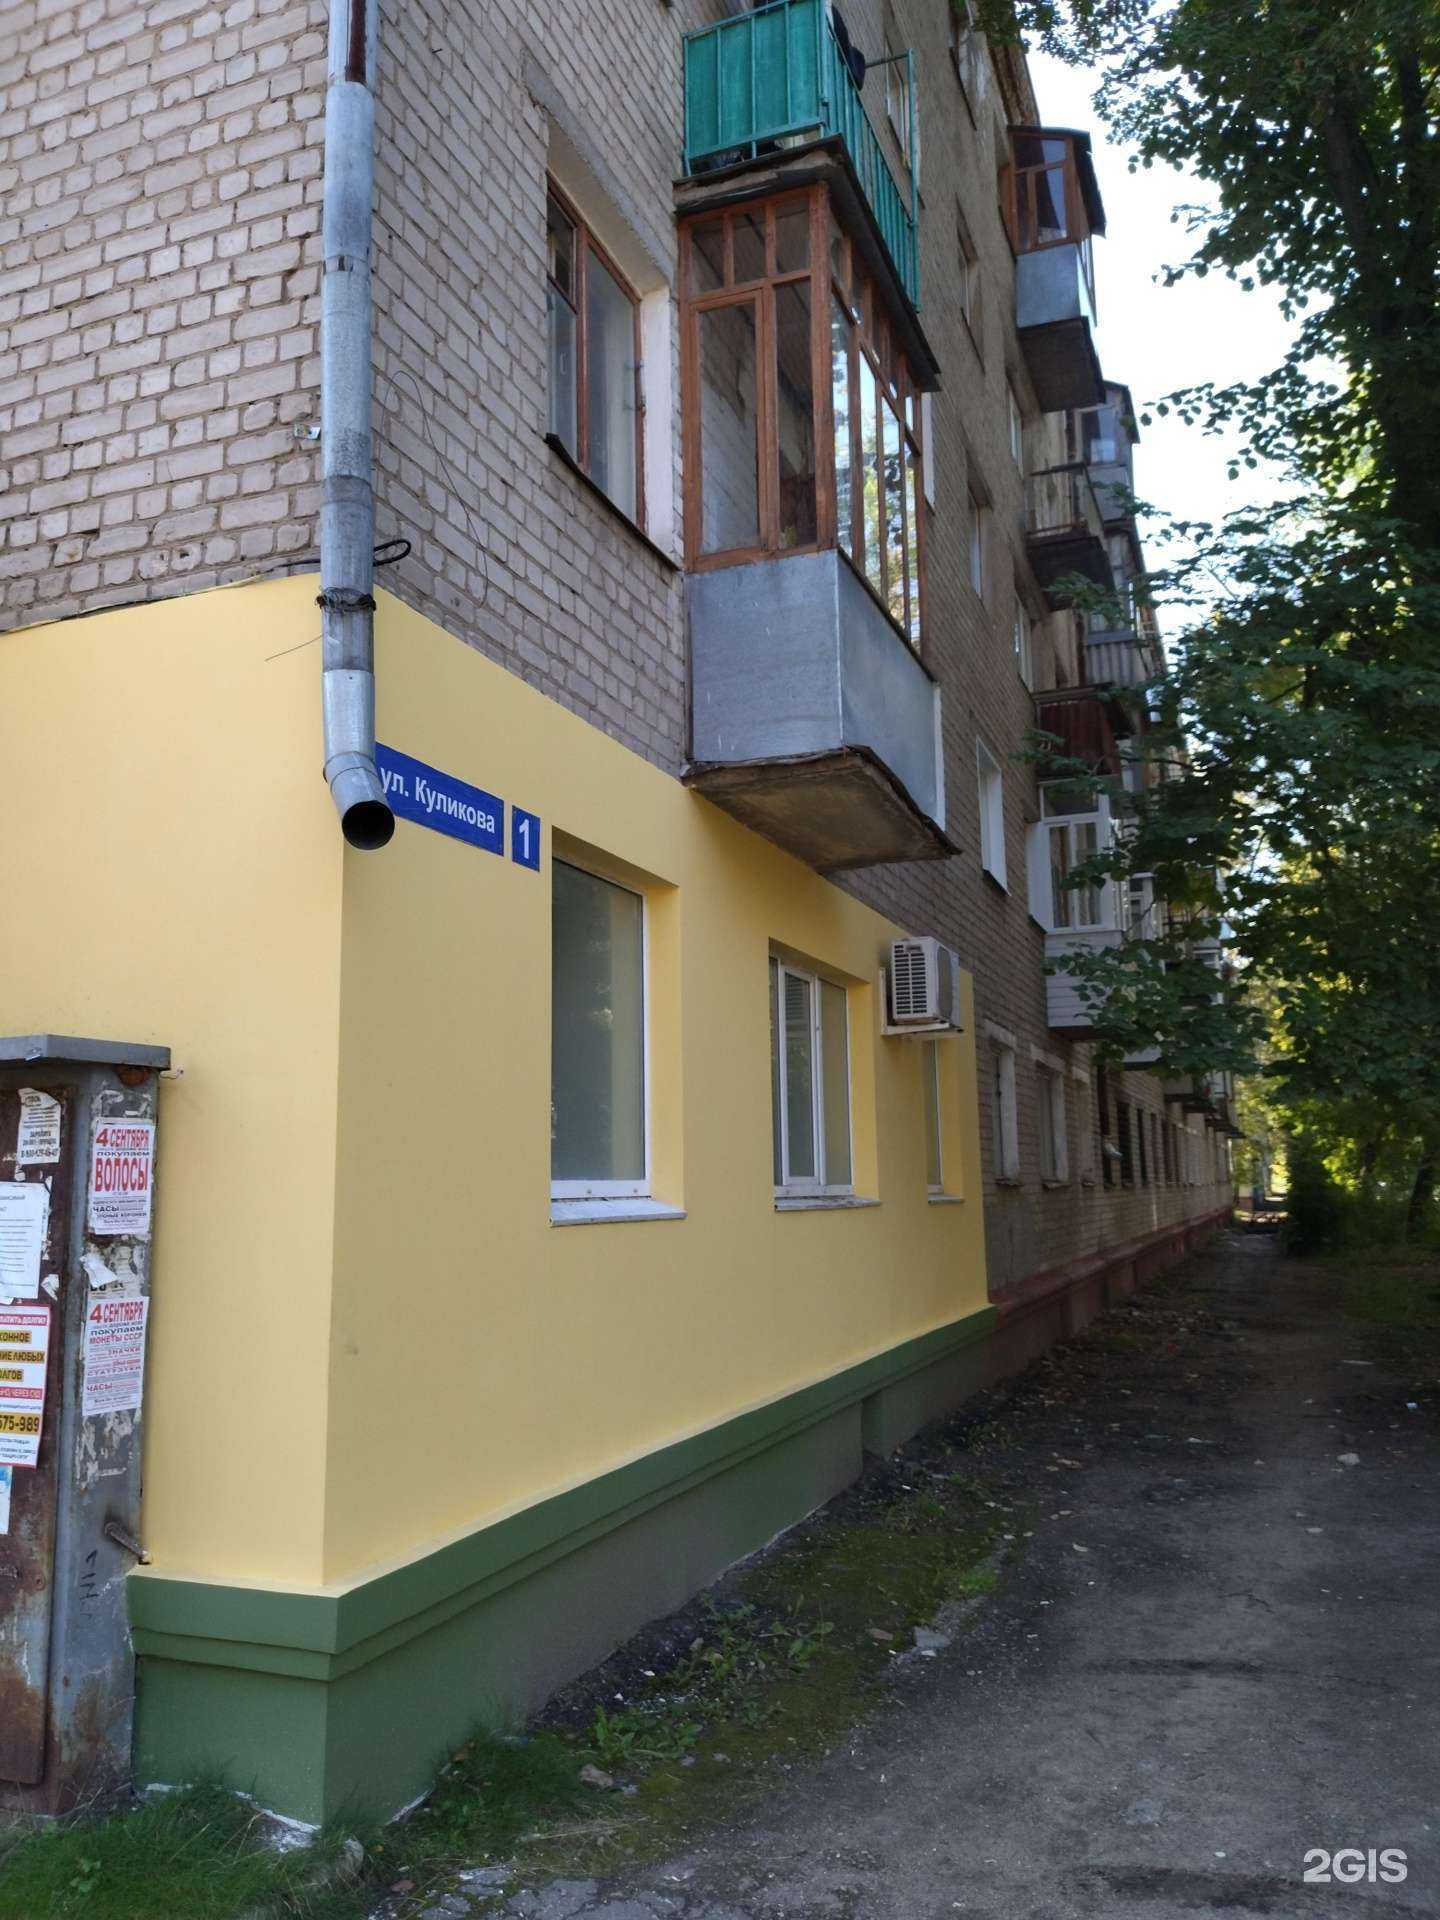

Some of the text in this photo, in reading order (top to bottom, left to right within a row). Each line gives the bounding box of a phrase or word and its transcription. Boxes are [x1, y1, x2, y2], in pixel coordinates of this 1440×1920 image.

[380, 767, 530, 860] ул. Куликова 1
[96, 1128, 149, 1148] 4 СЕНТЯБРЯ
[95, 1157, 148, 1192] ВОЛОСЫ
[90, 1301, 144, 1324] 4 СЕНТЯБРЯ
[89, 1334, 122, 1345] МОНЕТЫ
[124, 1332, 143, 1341] СССР
[13, 1351, 45, 1362] ЛЮБЫХ
